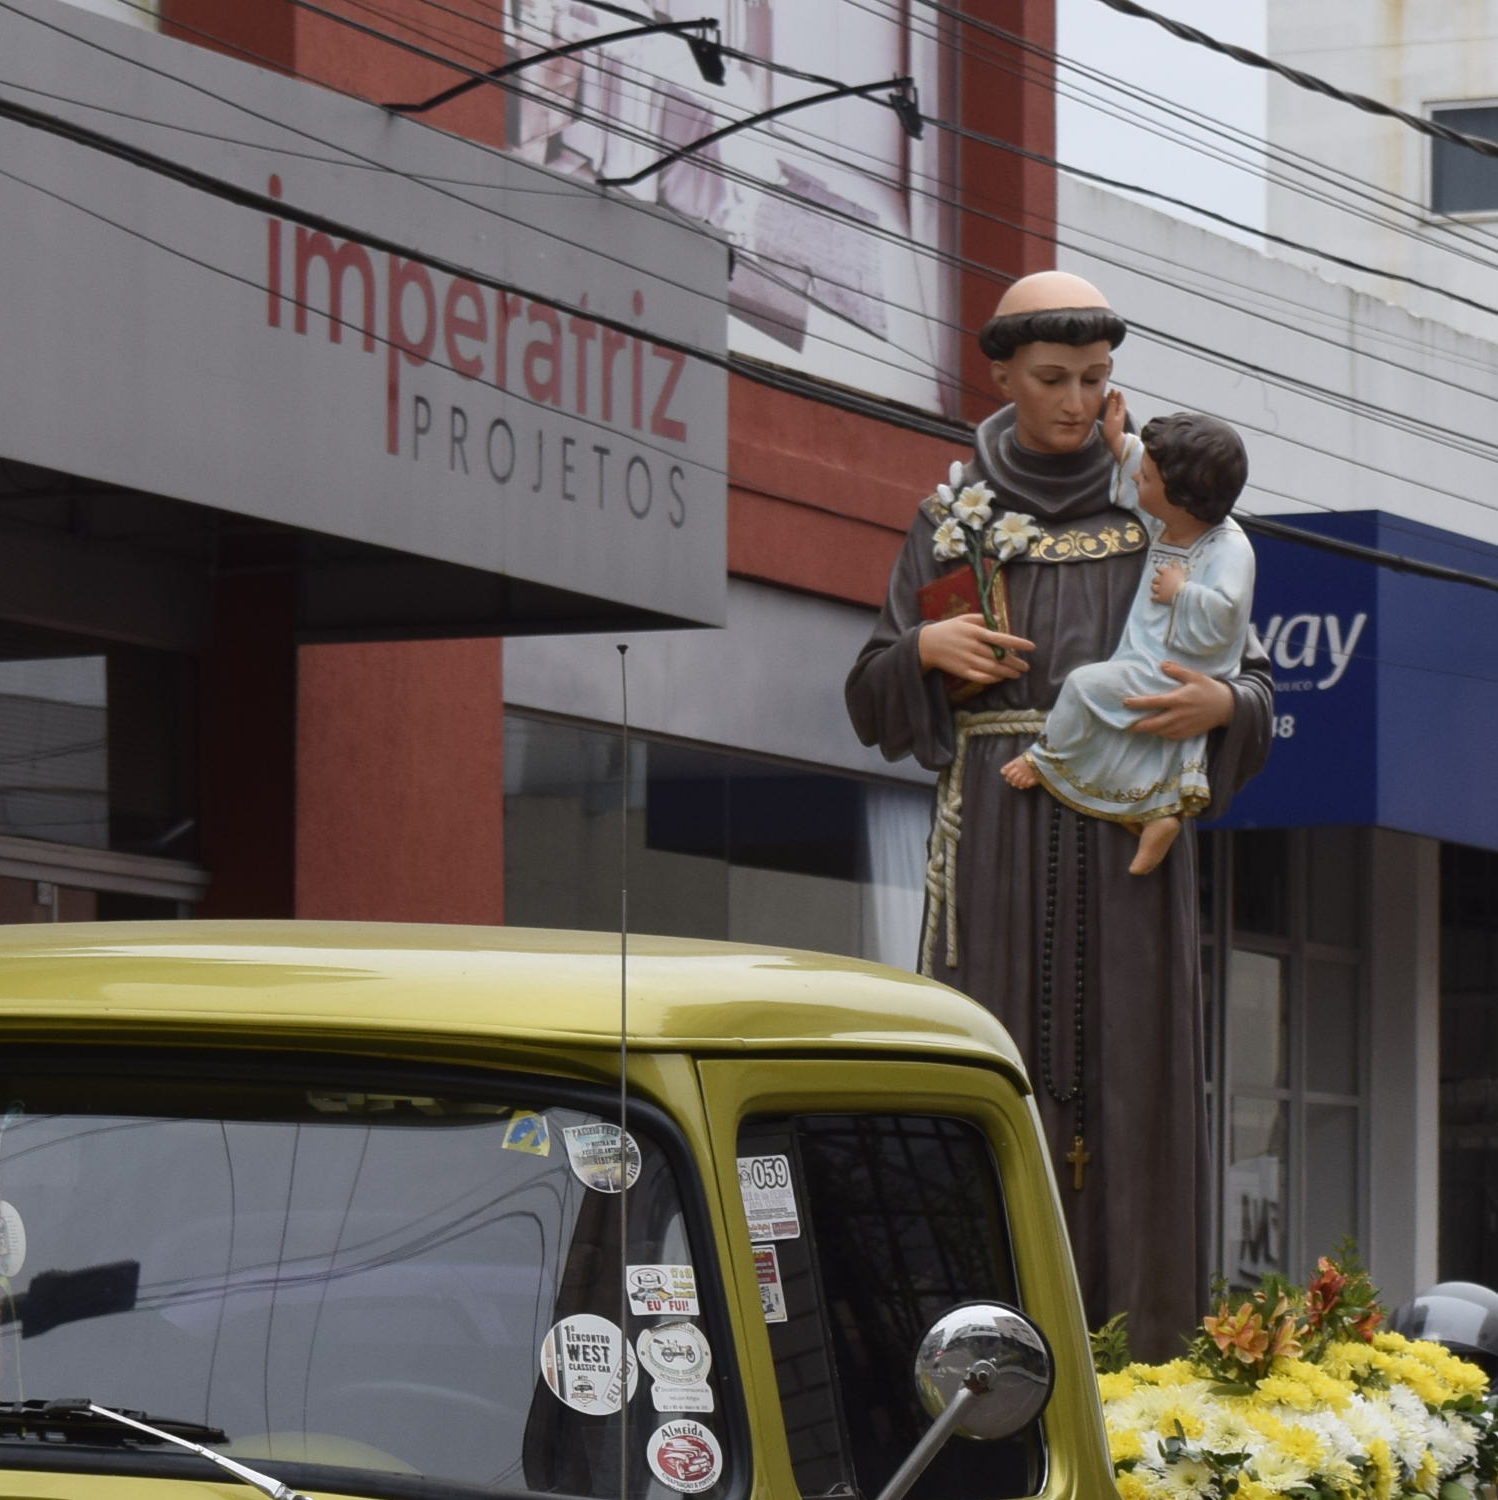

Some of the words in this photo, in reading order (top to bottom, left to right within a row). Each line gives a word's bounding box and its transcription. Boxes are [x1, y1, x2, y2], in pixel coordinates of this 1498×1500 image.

[266, 173, 688, 457] imperatriz
[412, 394, 687, 529] PROJETOS
[751, 1157, 788, 1189] 059
[647, 1301, 662, 1312] EU
[669, 1301, 690, 1312] FUI!
[571, 1333, 611, 1344] ENCONTRO
[566, 1344, 610, 1364] WEST
[569, 1363, 597, 1372] CLASSIC
[598, 1365, 611, 1373] CAR
